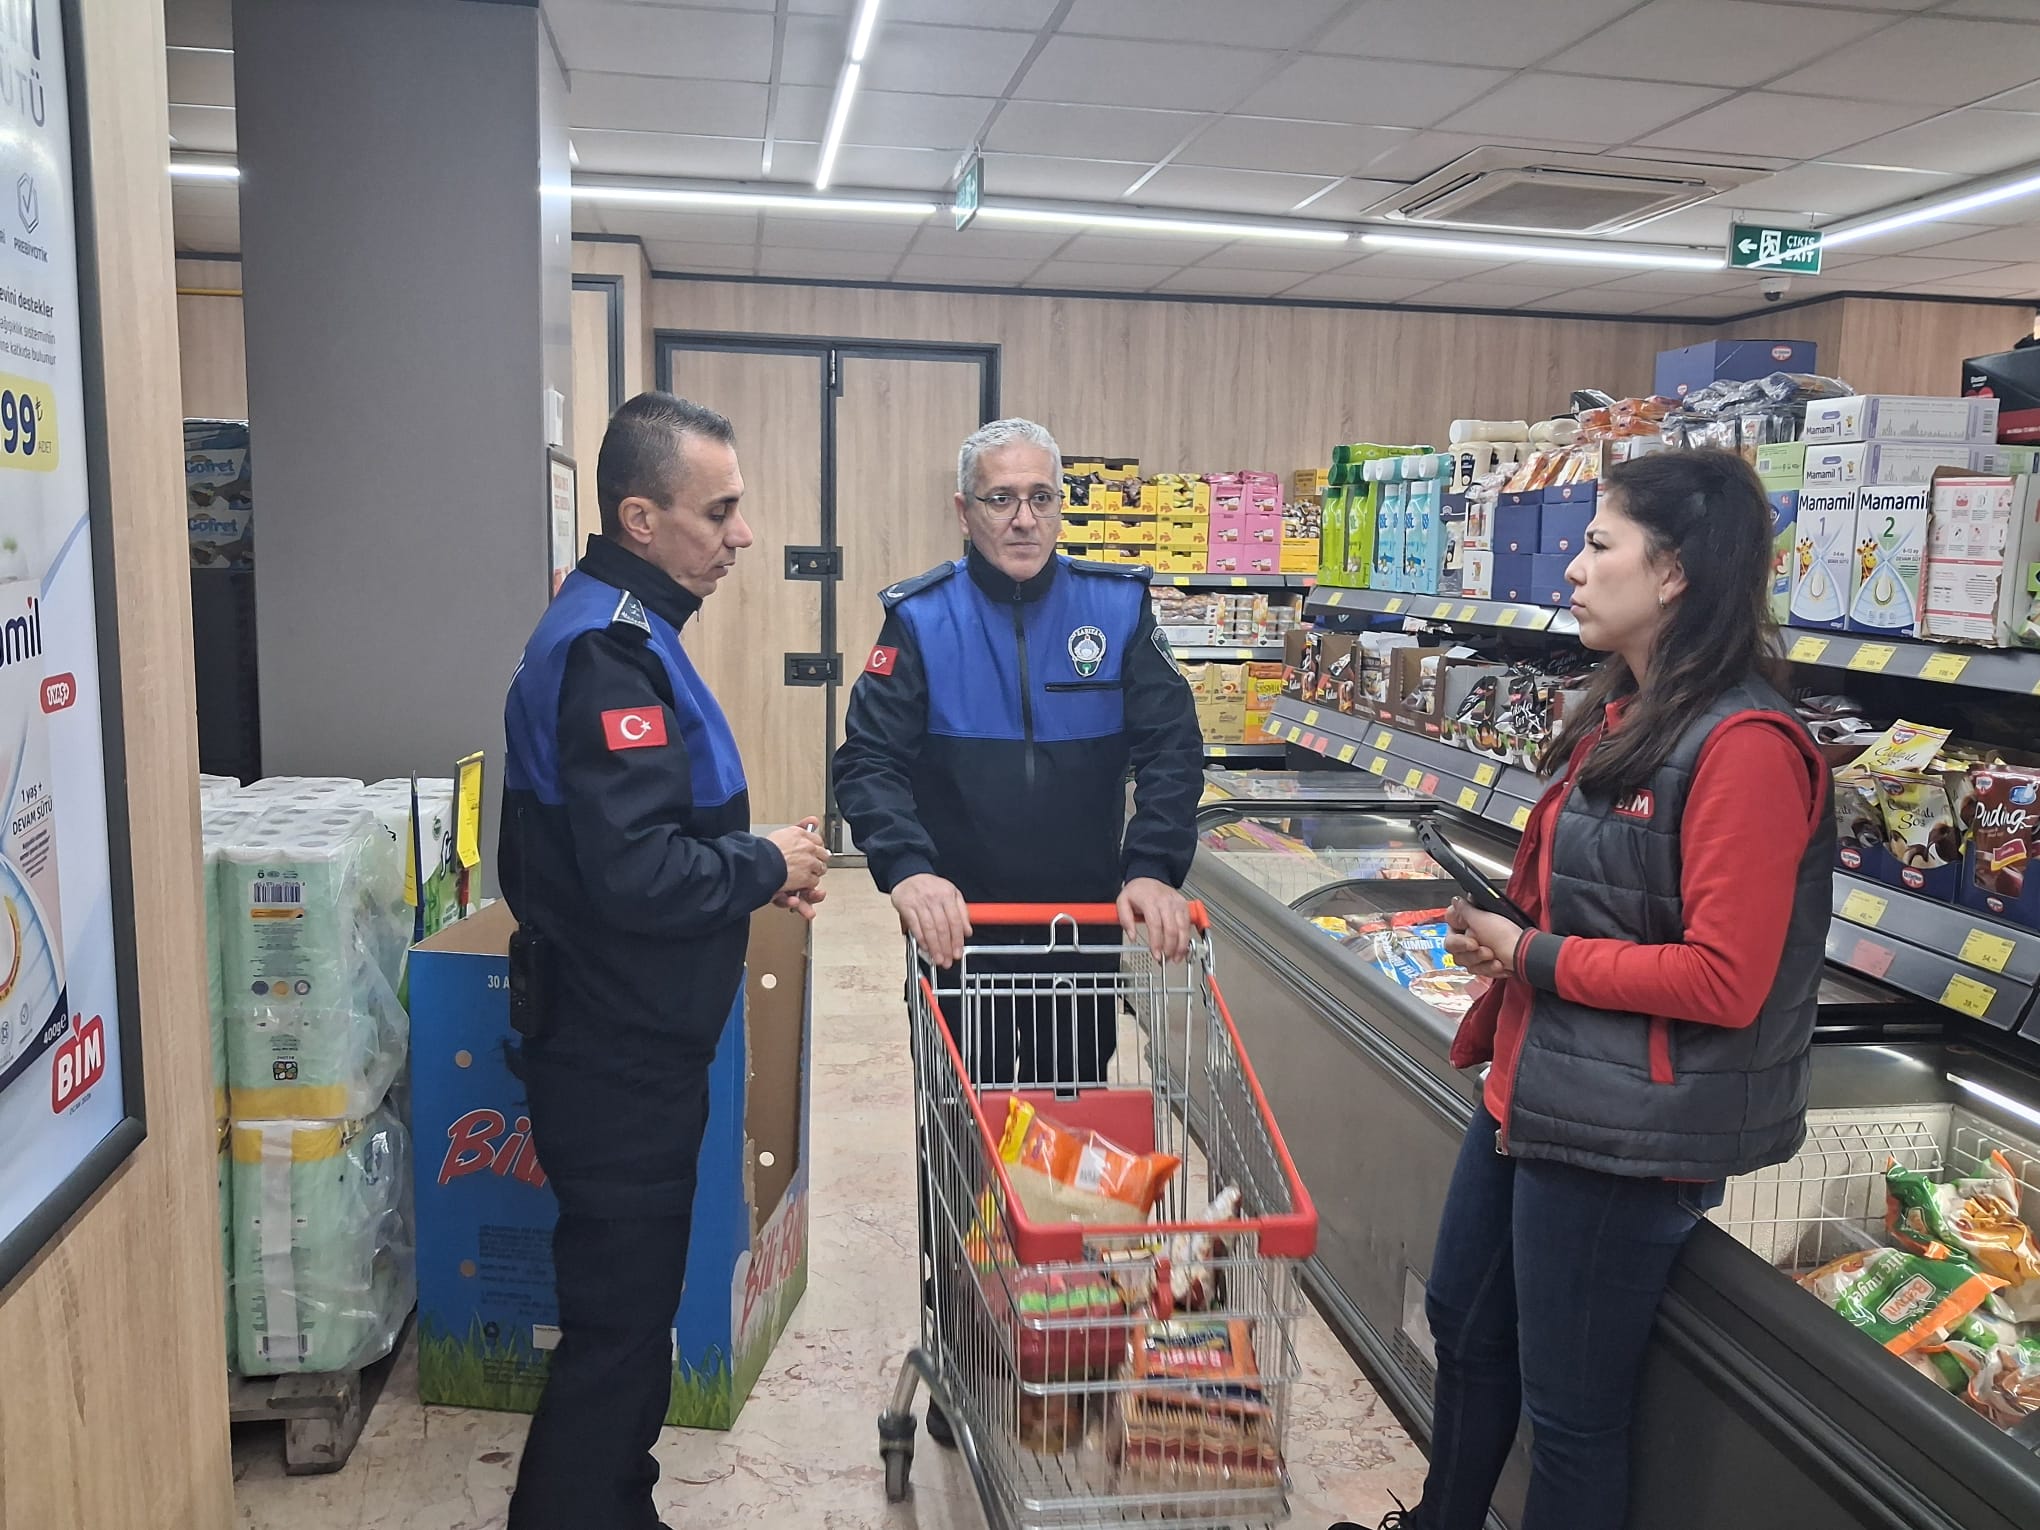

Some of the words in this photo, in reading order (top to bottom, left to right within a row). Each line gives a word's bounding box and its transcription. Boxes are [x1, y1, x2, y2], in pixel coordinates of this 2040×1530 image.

[1785, 249, 1814, 263] EXIT
[18, 292, 54, 318] destekler
[1806, 423, 1835, 435] Mamamil
[1836, 420, 1842, 437] 1
[1806, 468, 1836, 480] Mamamil
[1838, 466, 1843, 482] 1
[1798, 491, 1856, 512] Mamamil
[1819, 515, 1826, 537] 1
[1883, 516, 1896, 538] 2
[12, 806, 37, 836] DEVAM
[488, 974, 500, 989] 30
